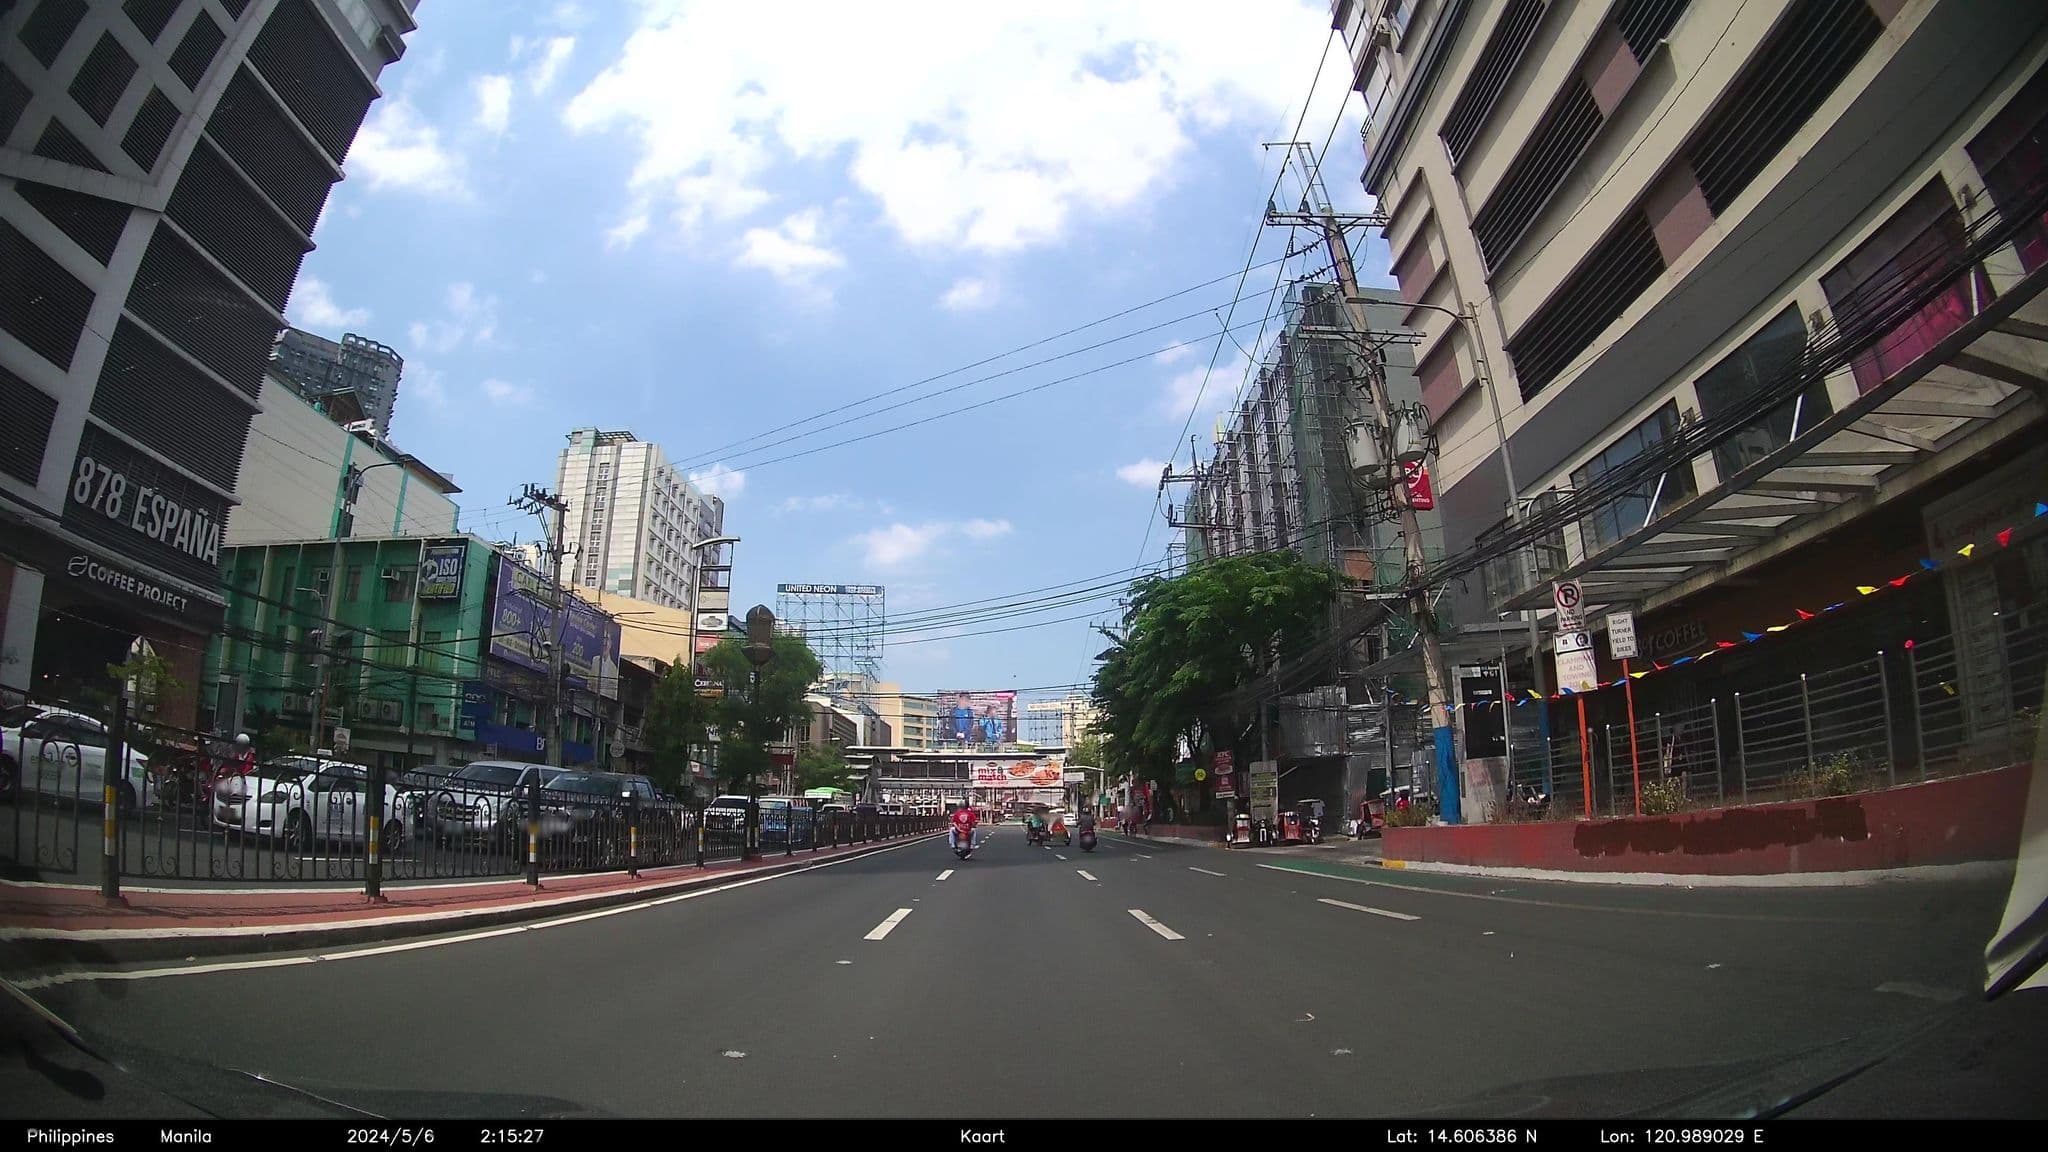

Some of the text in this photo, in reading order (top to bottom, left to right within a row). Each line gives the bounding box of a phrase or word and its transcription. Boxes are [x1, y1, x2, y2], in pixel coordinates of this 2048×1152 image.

[74, 456, 221, 566] 878 ESPAÑA
[439, 558, 459, 576] ISO
[88, 562, 187, 613] COFFEE PROJECT
[814, 585, 837, 593] NEON
[1560, 614, 1583, 623] PARKING
[1656, 617, 1705, 649] COFFEE
[1562, 672, 1592, 681] TOWING
[977, 766, 996, 774] mix
